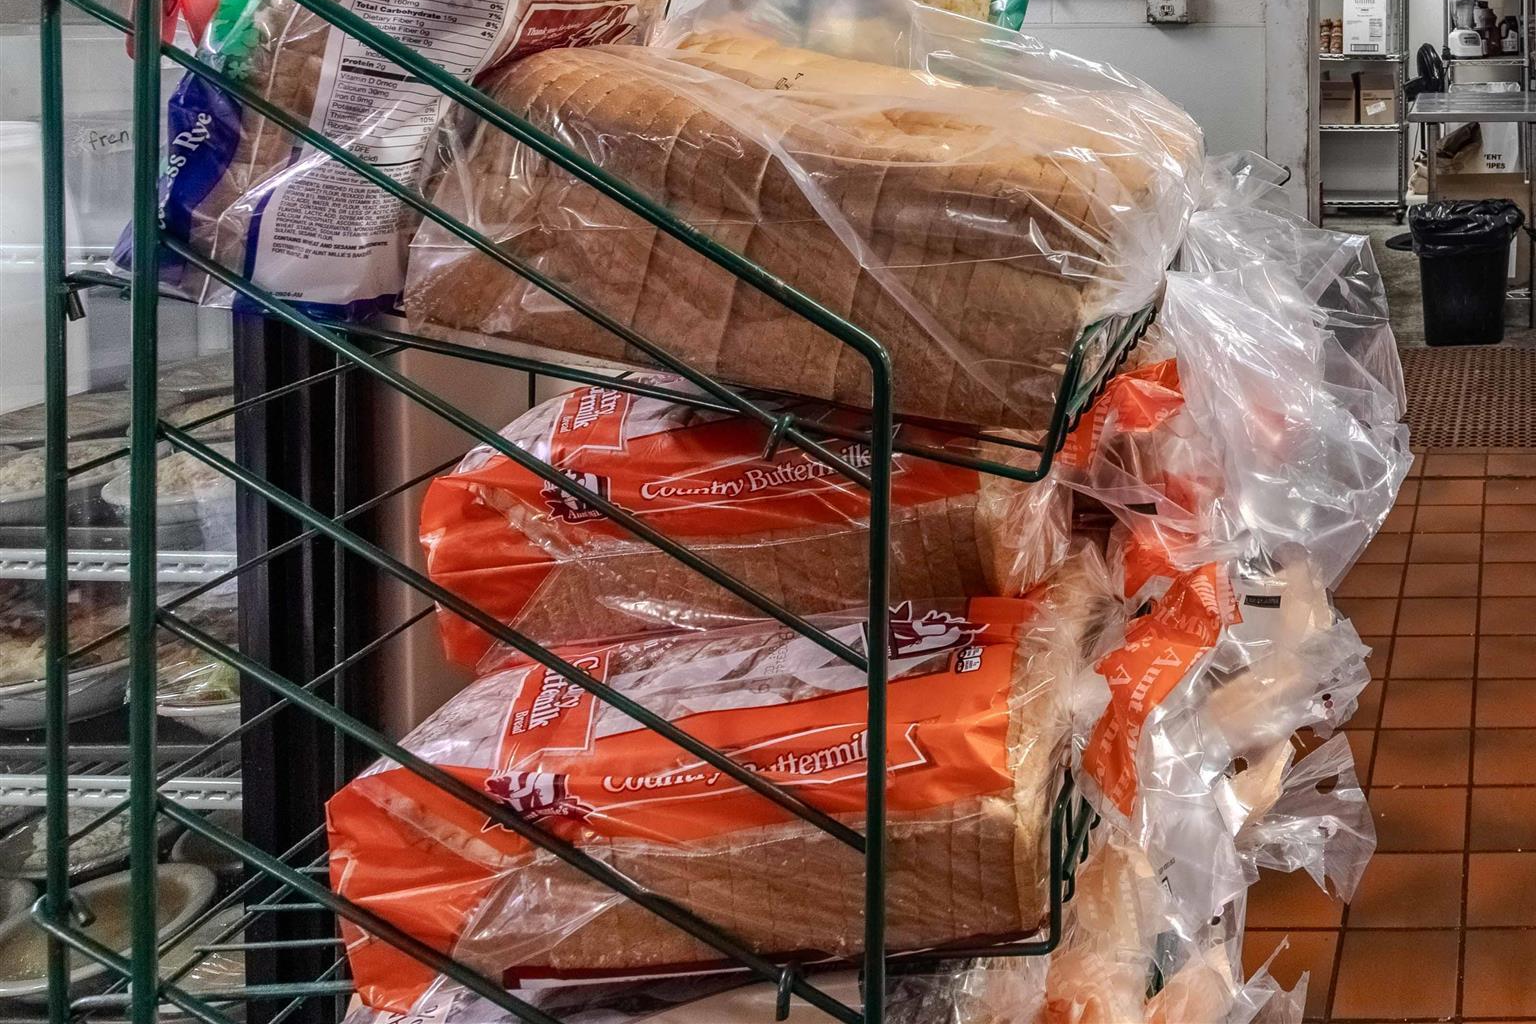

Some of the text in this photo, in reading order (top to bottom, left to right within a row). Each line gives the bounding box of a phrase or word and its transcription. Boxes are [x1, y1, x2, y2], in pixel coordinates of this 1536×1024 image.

[357, 0, 378, 11] Total
[380, 6, 442, 19] Carbohydrate
[490, 3, 504, 11] 0%
[363, 12, 425, 27] Dietary Fiber 1g
[398, 26, 418, 34] Fiber
[420, 28, 431, 36] 0g
[423, 39, 433, 47] 0g
[342, 57, 386, 71] Protein 2g
[340, 73, 367, 82] Vitamin
[338, 83, 367, 93] Calcium
[172, 112, 213, 152] Rye
[1128, 646, 1183, 713] Aunt
[512, 710, 529, 735] Bread
[744, 728, 868, 777] uttermil
